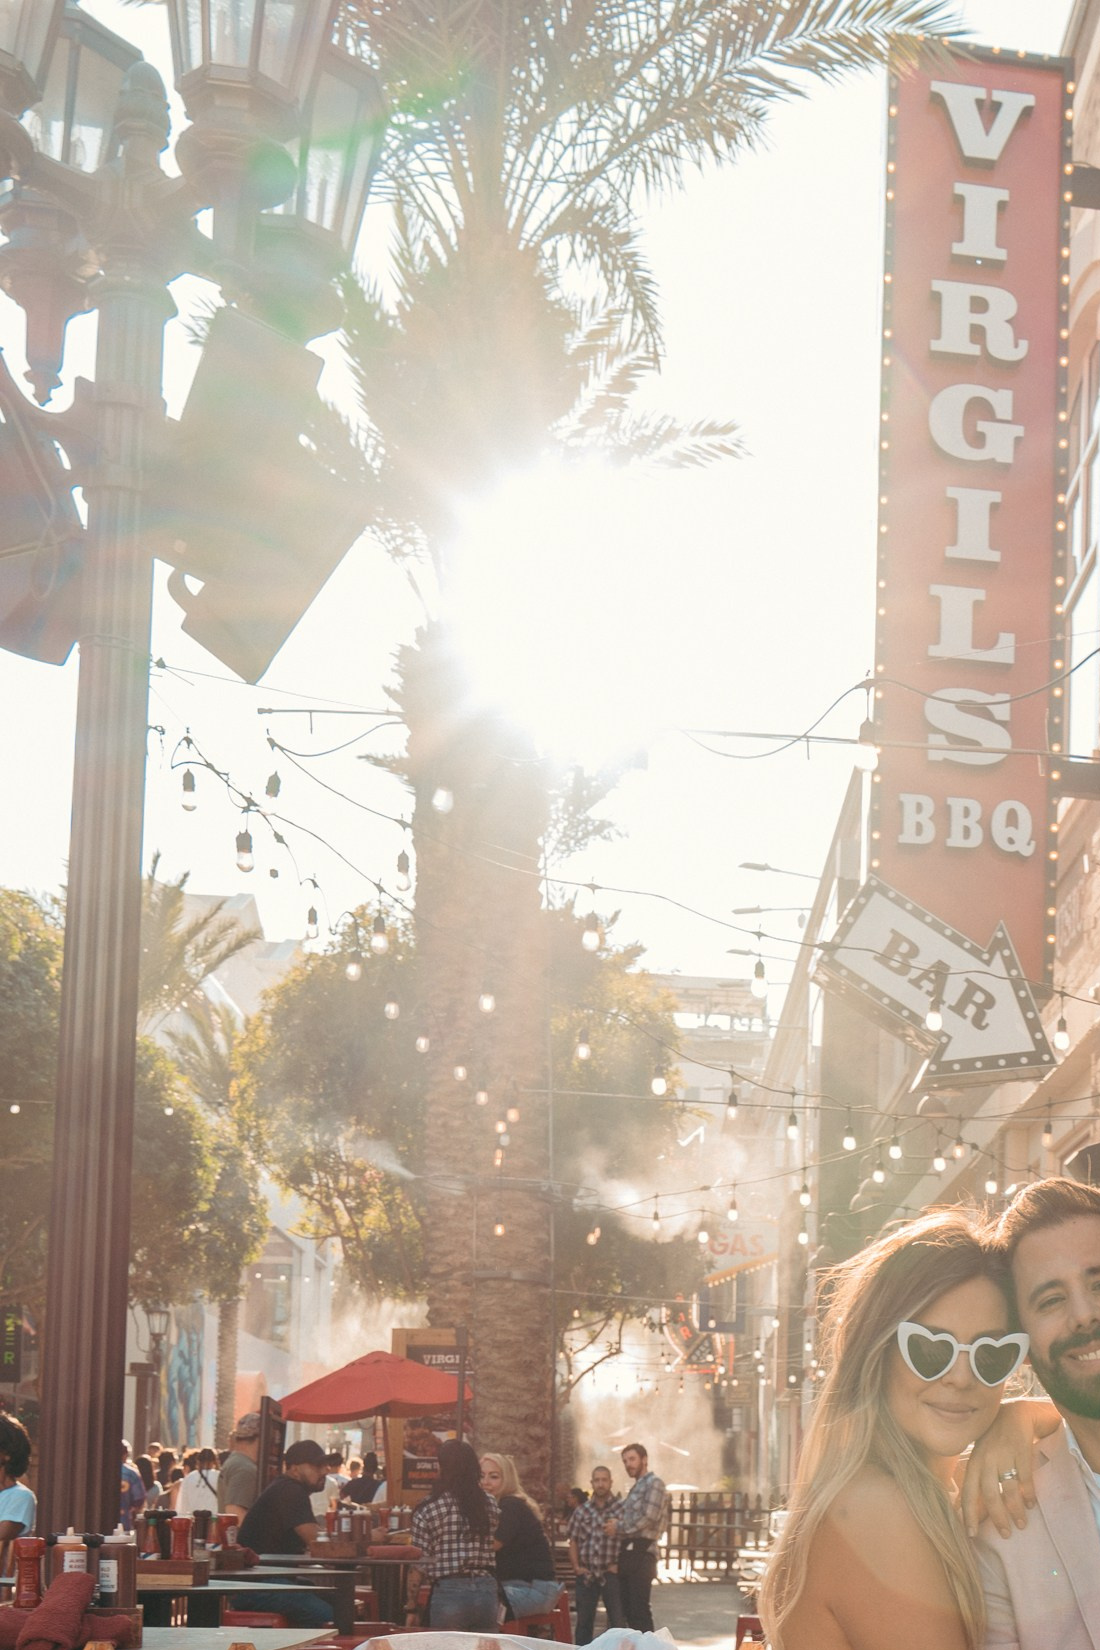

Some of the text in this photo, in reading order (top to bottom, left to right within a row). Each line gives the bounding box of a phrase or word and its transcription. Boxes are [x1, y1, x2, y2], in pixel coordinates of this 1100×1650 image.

[898, 793, 1036, 858] BBQ
[873, 929, 997, 1031] BAR
[423, 1354, 468, 1365] VIRGI
